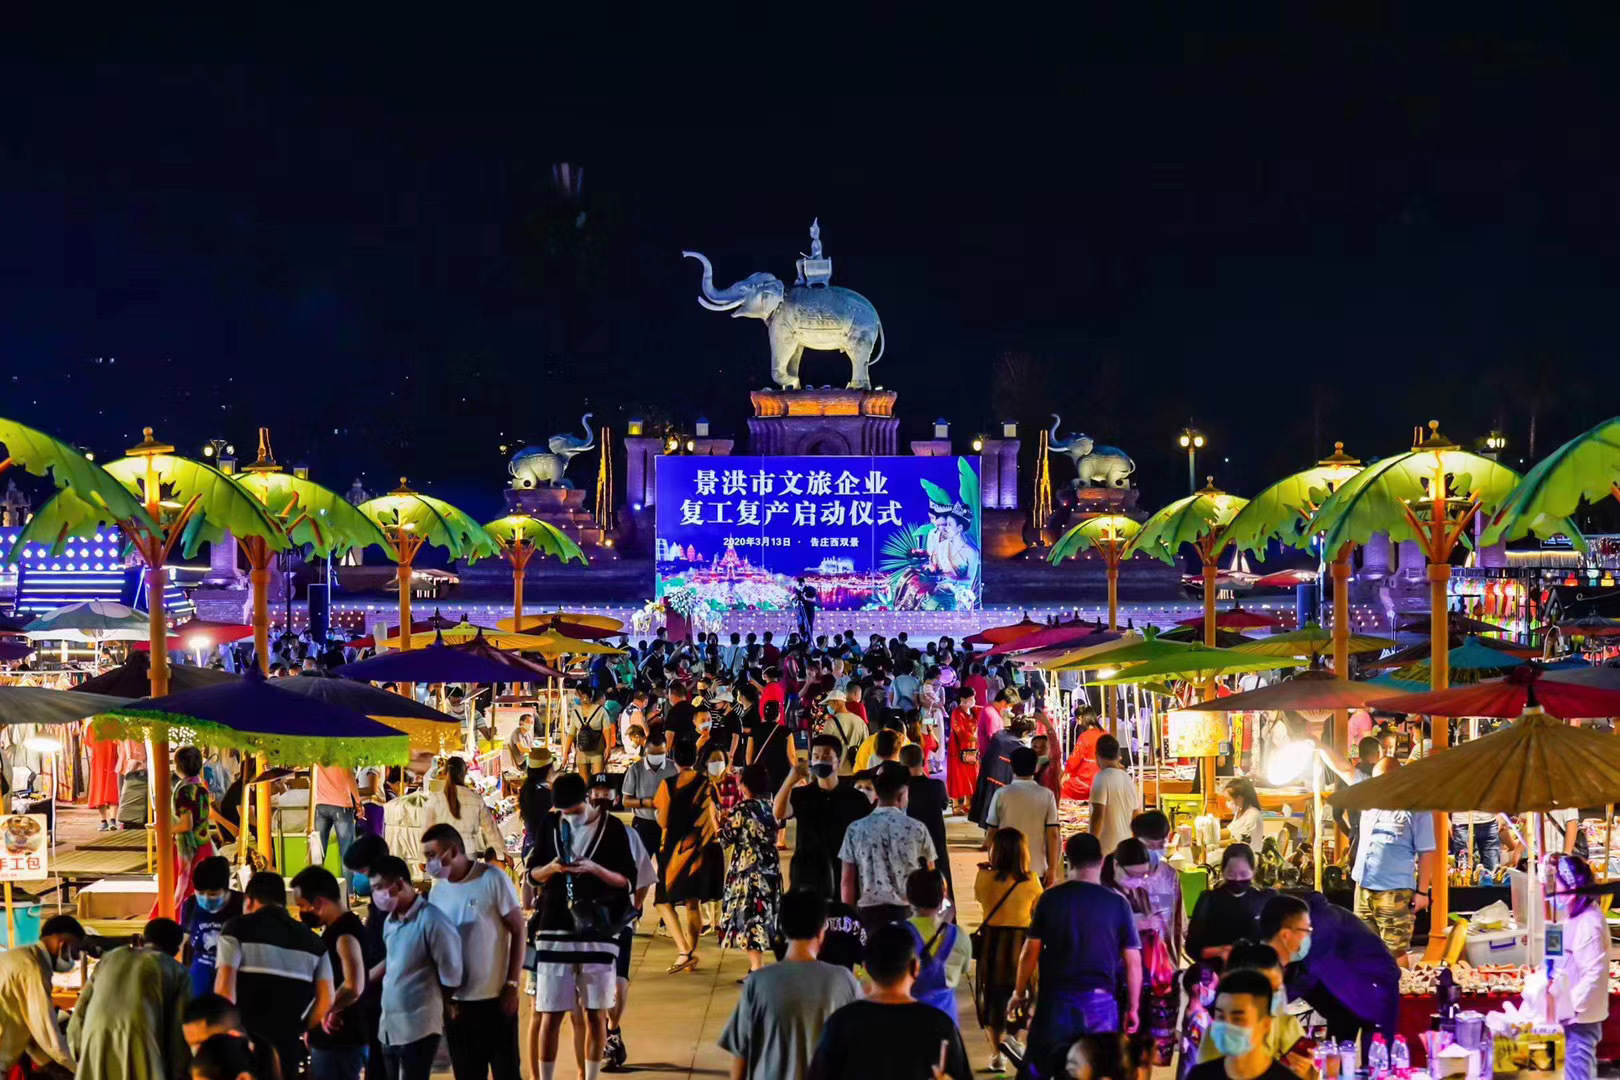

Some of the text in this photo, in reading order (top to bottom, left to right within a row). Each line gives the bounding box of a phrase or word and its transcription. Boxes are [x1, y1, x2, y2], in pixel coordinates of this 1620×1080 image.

[694, 469, 889, 496] 景洪市文旅企业
[680, 499, 903, 526] 复工复产启动仪式
[723, 536, 791, 547] 2020年3月13日
